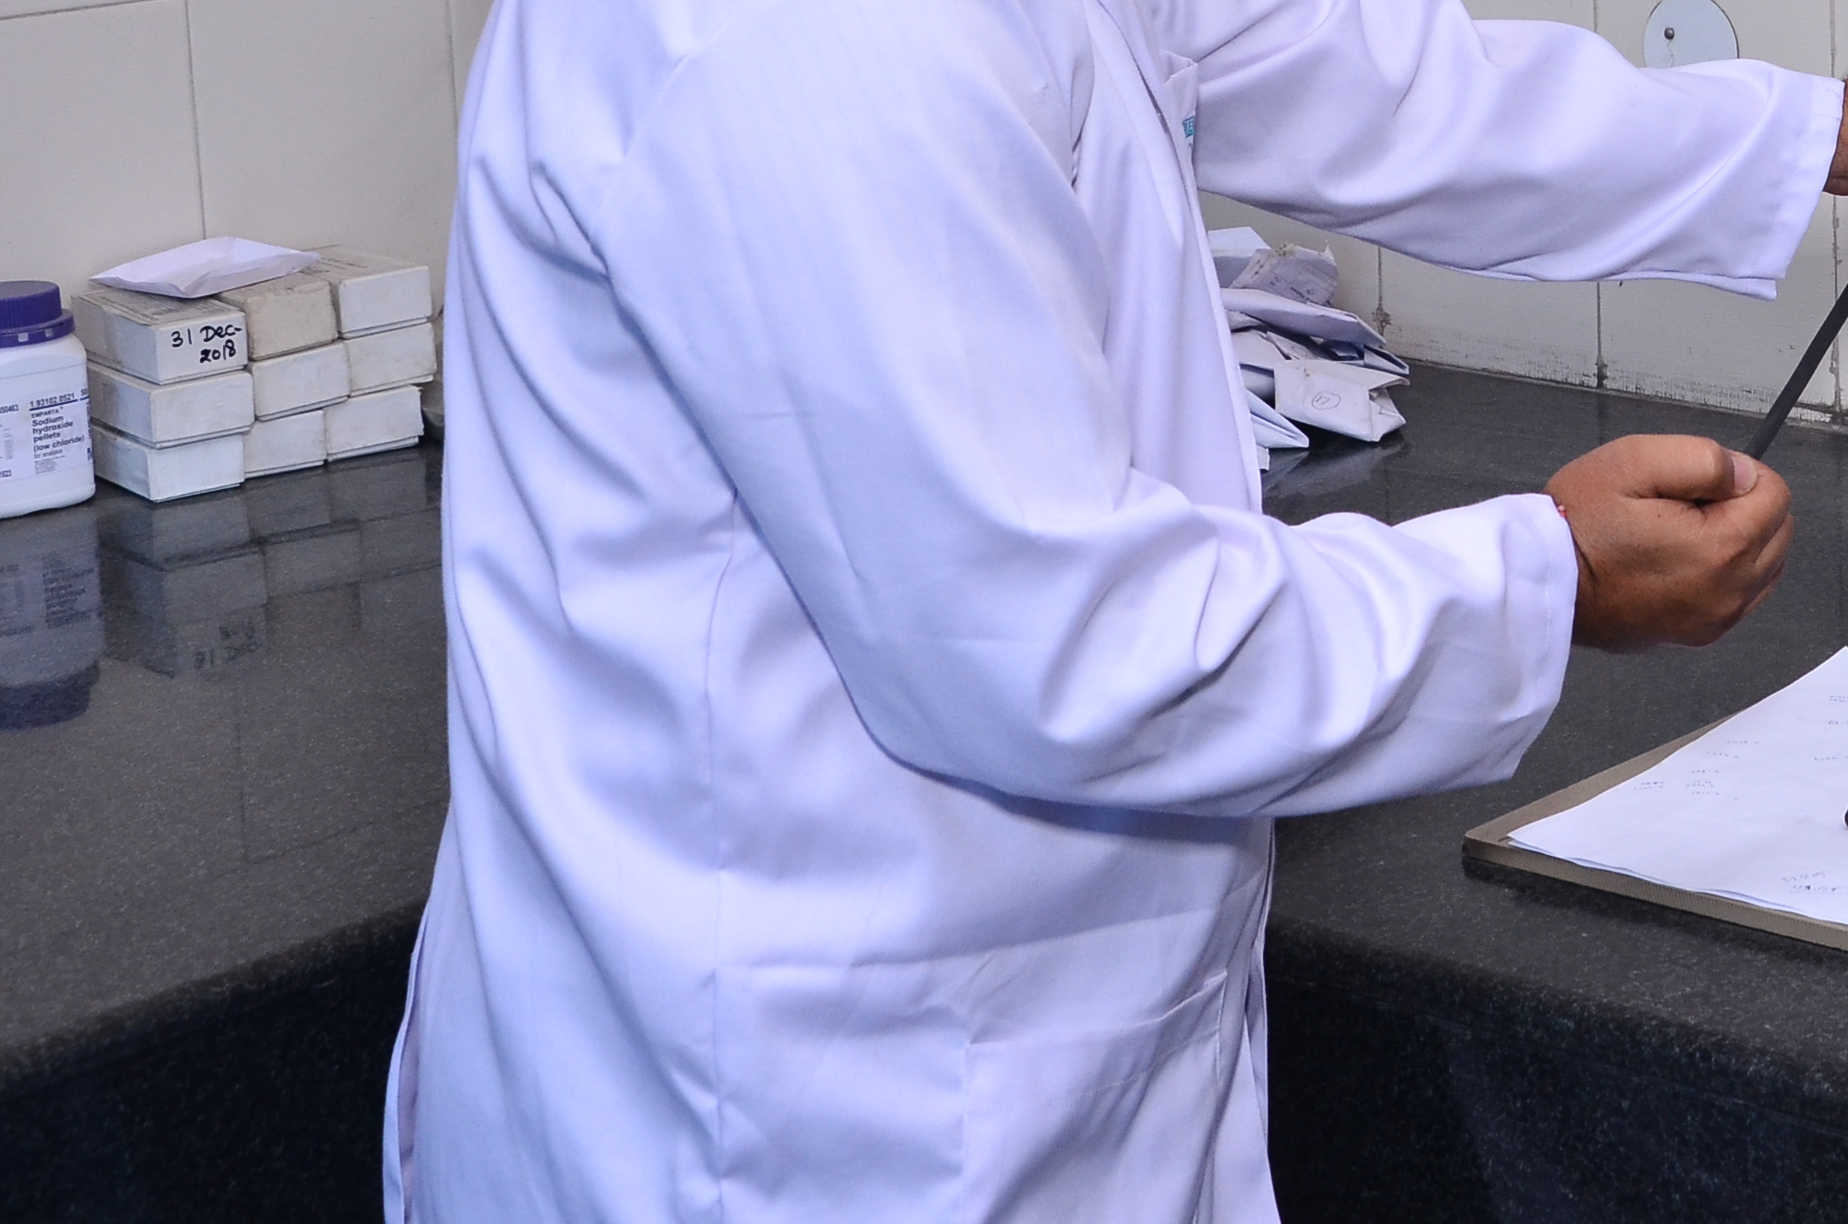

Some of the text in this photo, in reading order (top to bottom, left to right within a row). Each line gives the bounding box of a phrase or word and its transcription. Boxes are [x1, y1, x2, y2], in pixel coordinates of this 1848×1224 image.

[171, 327, 193, 348] 31
[199, 341, 237, 364] 2018
[32, 416, 63, 427] Sodium
[32, 422, 73, 435] hydroxide
[33, 432, 61, 443] pellets
[34, 435, 85, 453] (low chloride)
